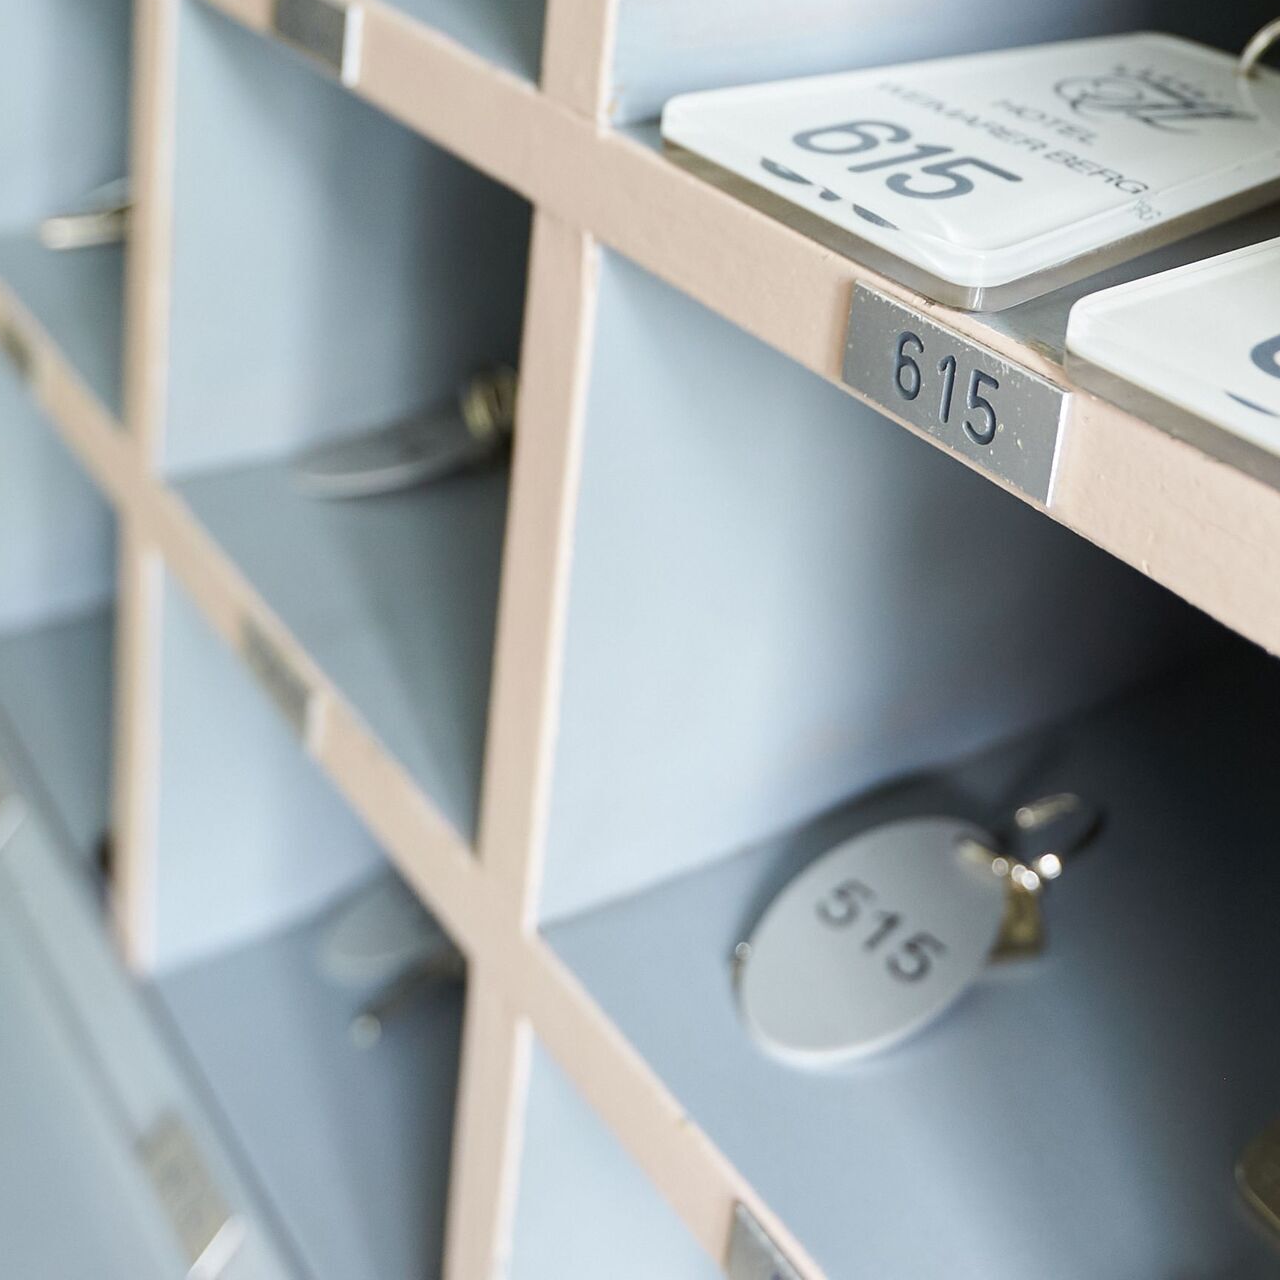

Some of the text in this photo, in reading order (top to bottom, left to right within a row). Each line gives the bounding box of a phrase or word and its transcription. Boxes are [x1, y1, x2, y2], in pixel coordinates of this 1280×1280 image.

[791, 119, 1024, 201] 615
[991, 98, 1099, 146] HOTEL
[1044, 150, 1150, 195] BERG
[894, 331, 1000, 446] 615
[815, 878, 949, 983] 515
